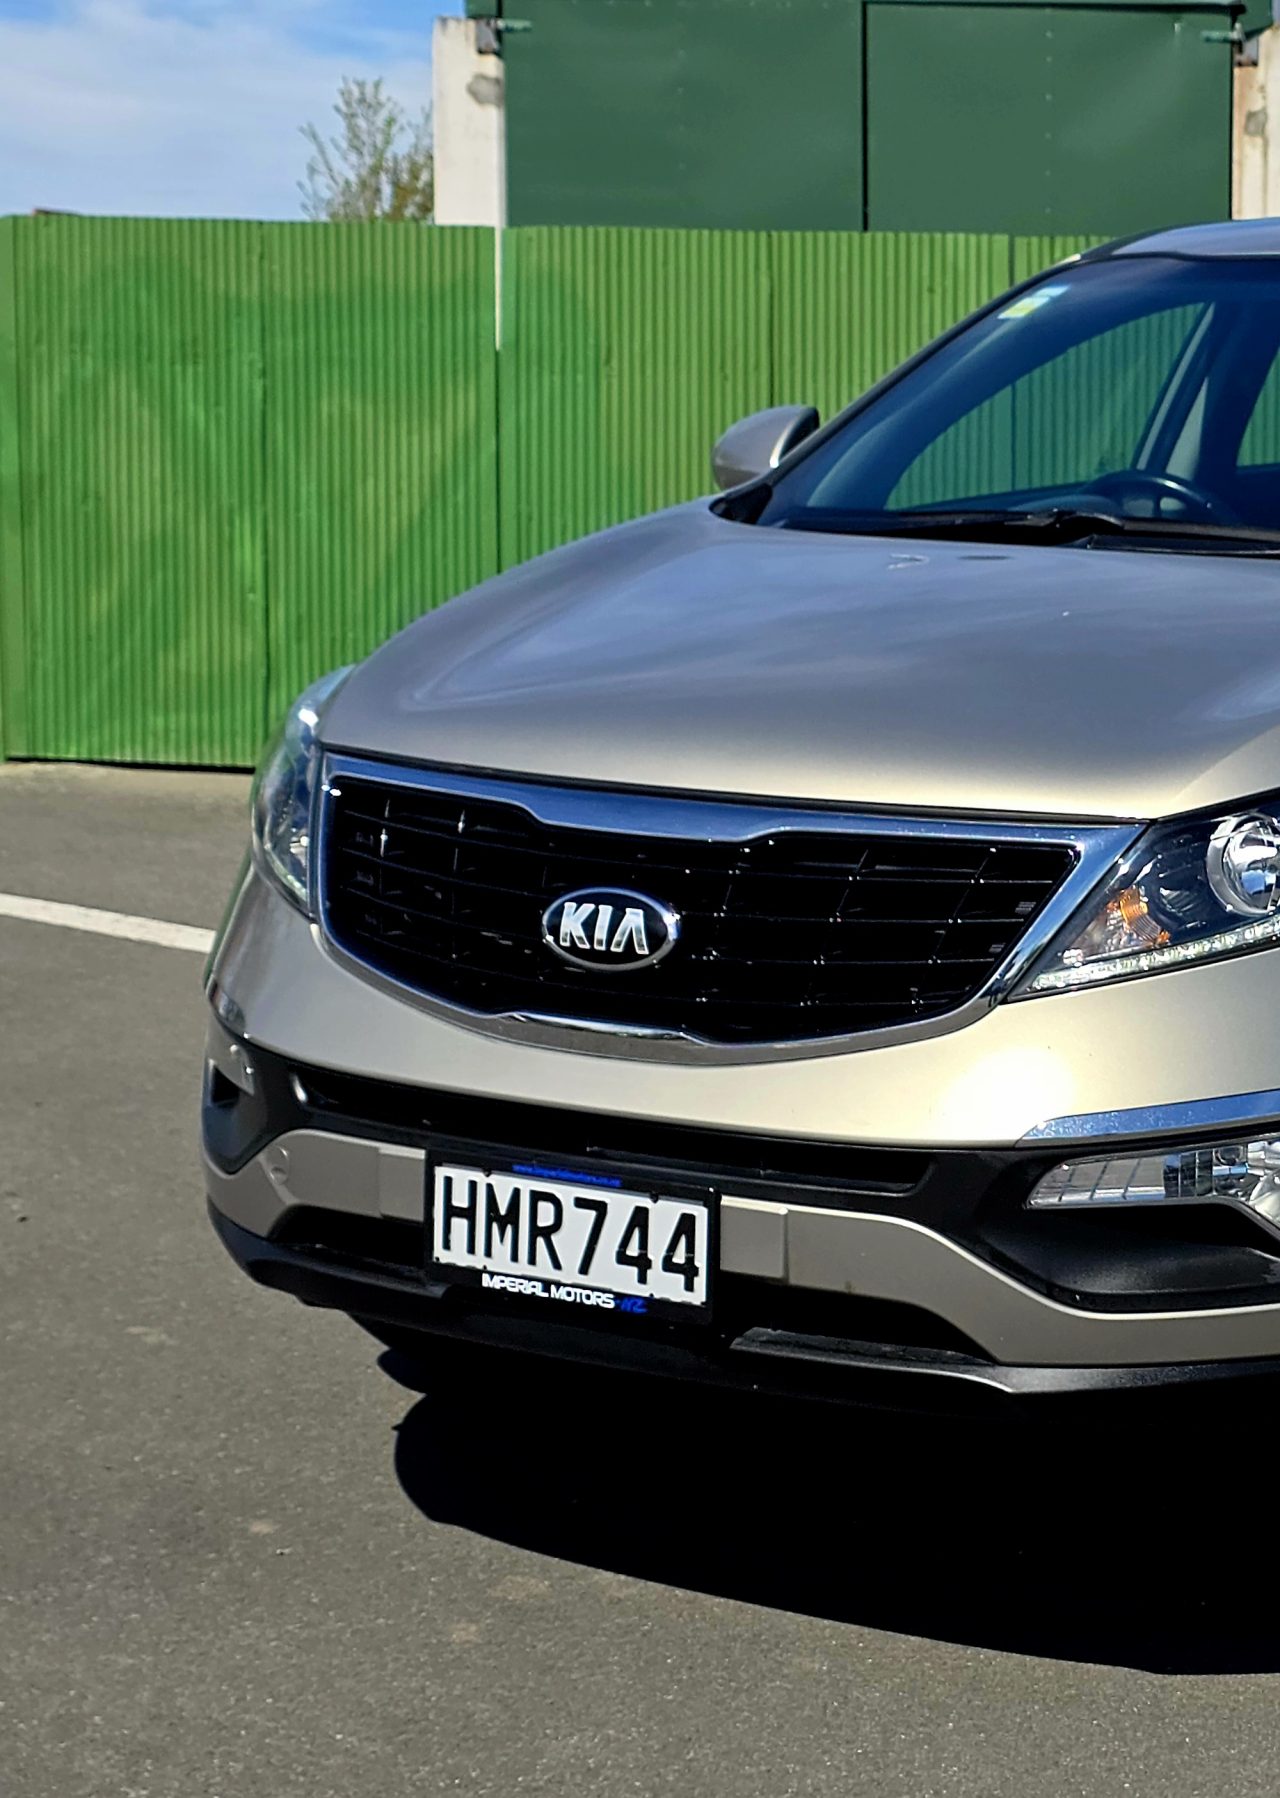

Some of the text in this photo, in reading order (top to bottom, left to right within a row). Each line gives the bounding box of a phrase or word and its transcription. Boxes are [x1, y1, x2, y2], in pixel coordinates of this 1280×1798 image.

[559, 901, 649, 955] KIA
[442, 1175, 699, 1293] HMR744
[481, 1272, 549, 1297] IMPERIAL
[550, 1284, 615, 1309] MOTORS
